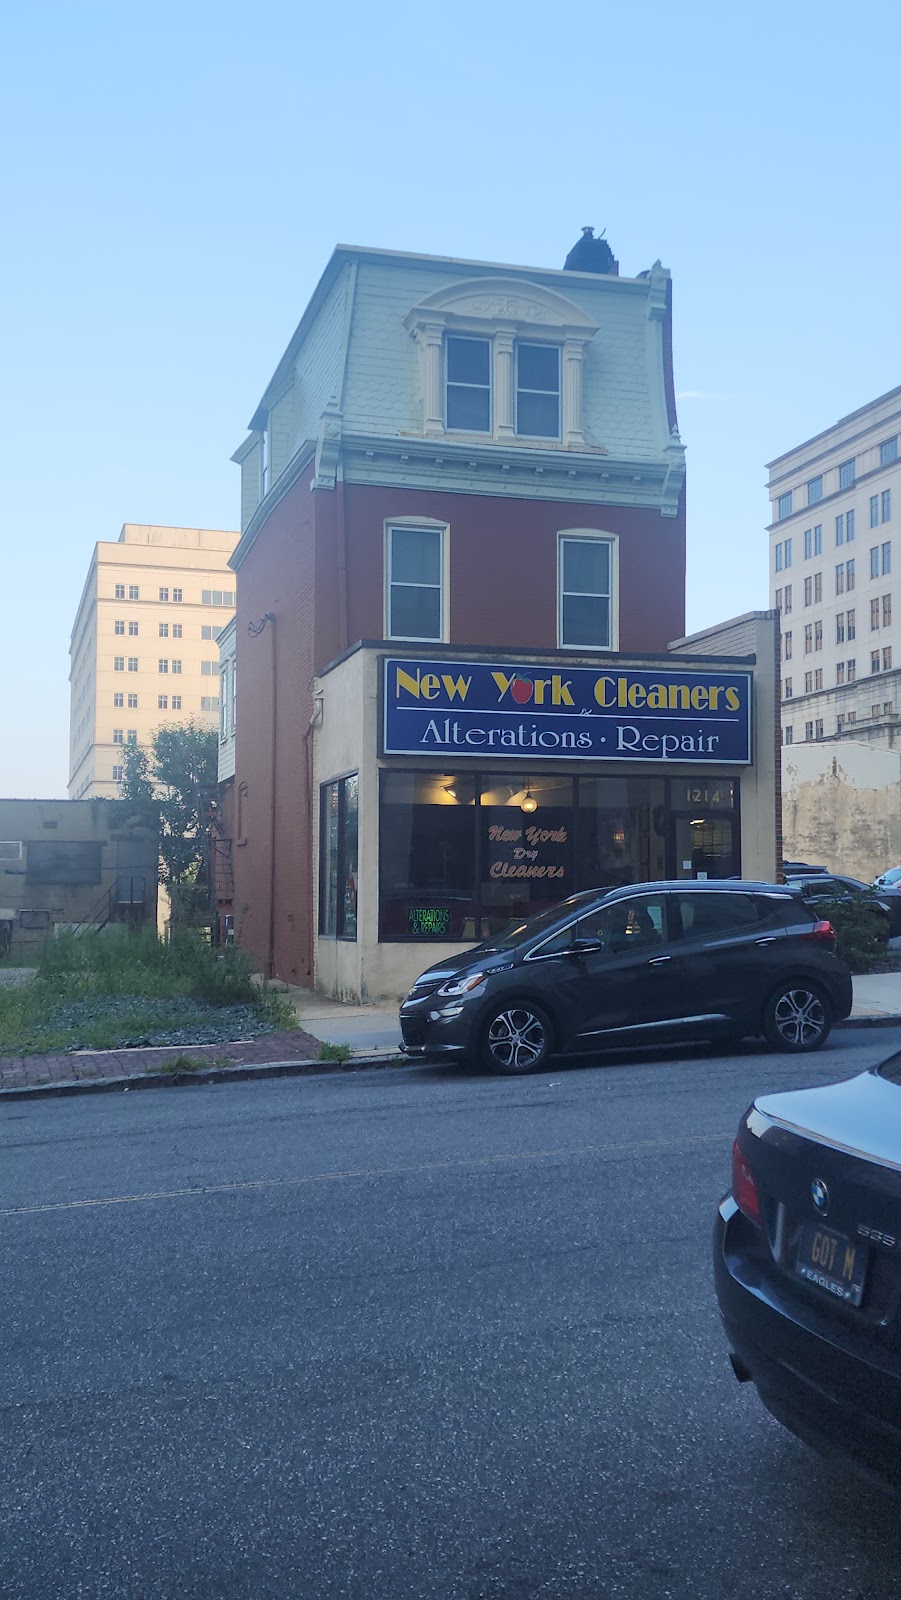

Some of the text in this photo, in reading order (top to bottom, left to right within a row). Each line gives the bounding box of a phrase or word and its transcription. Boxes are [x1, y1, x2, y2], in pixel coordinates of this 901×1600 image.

[396, 666, 472, 702] New
[593, 676, 740, 712] Cleaners
[419, 718, 720, 759] Alterations Repair
[686, 788, 720, 804] 1214
[488, 825, 568, 846] New York
[513, 847, 539, 862] Dry
[489, 861, 565, 878] Cleaners
[408, 909, 450, 922] ALTERATIONS
[411, 921, 446, 935] & REPAIRS
[811, 1231, 839, 1271] GOT
[806, 1269, 844, 1298] EAGLES
